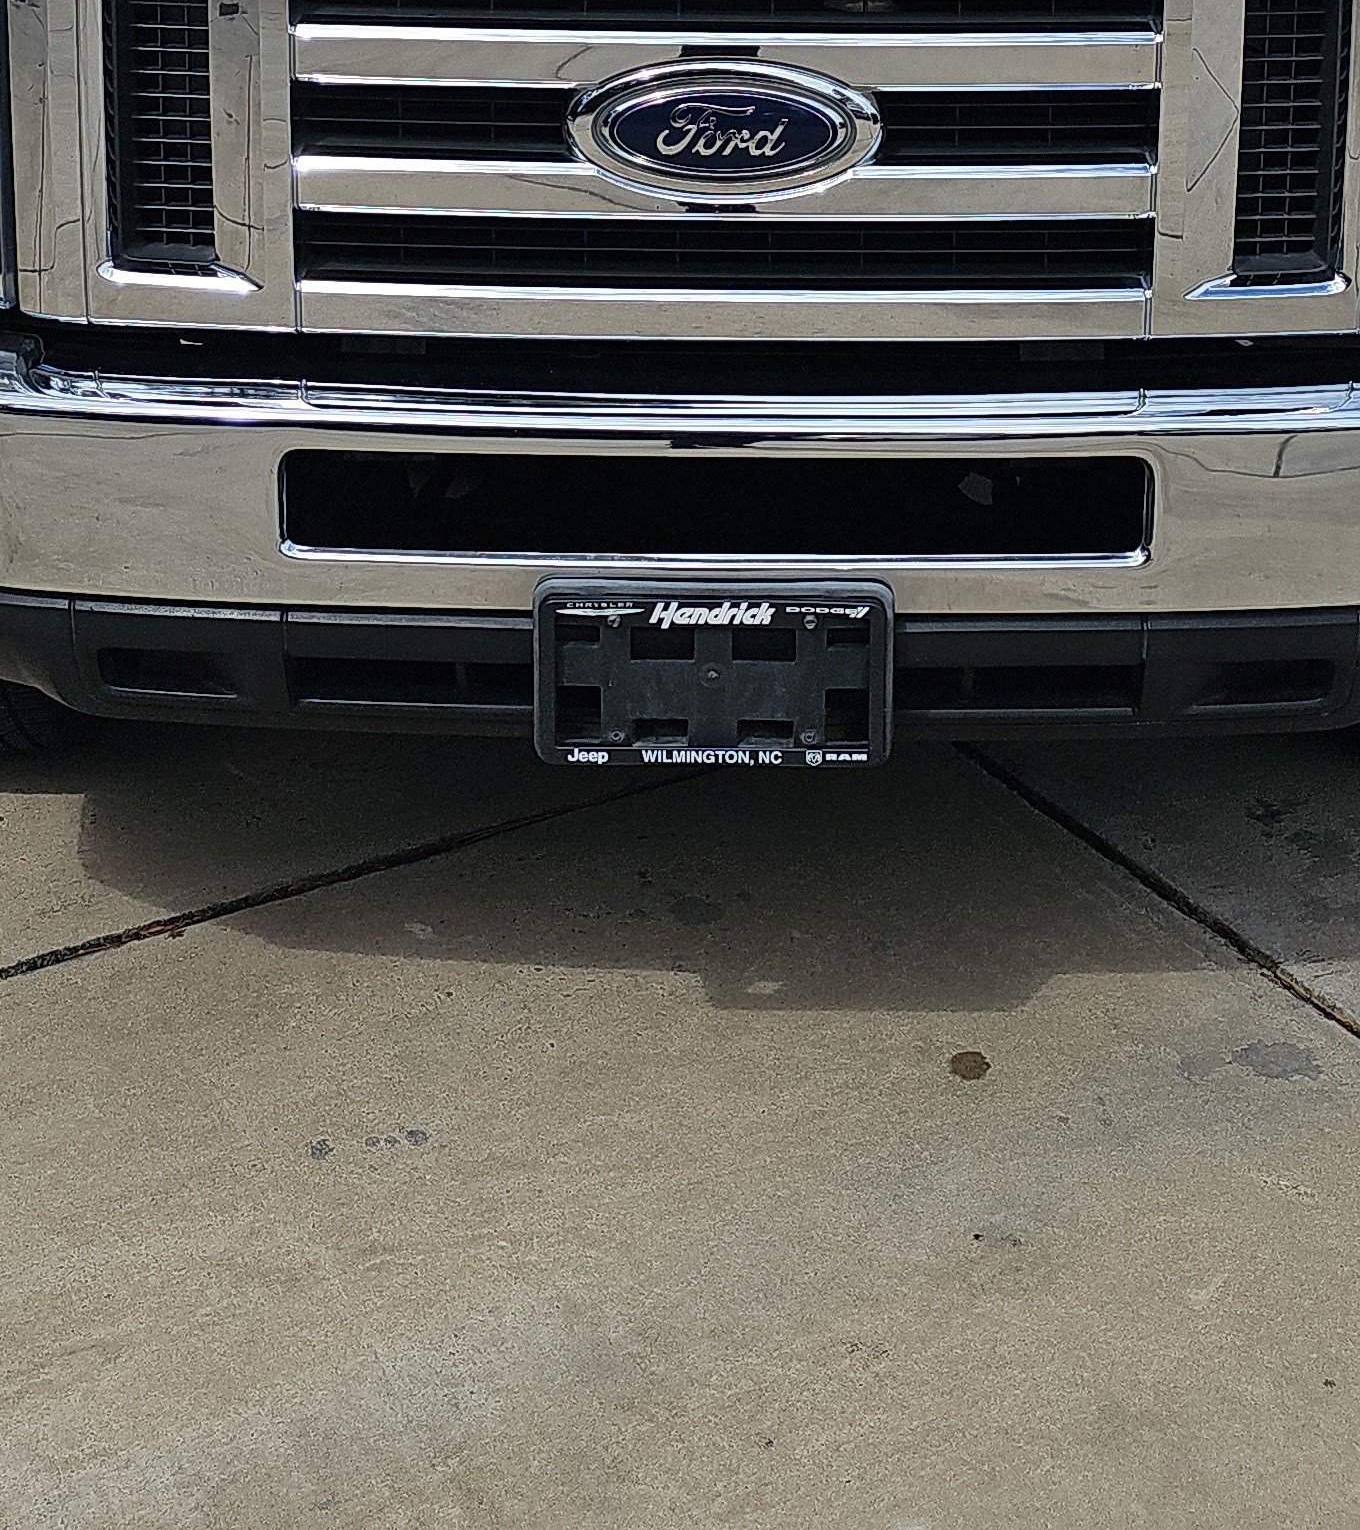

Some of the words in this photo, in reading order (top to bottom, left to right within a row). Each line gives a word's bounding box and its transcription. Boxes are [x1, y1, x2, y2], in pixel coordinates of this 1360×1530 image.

[656, 102, 789, 157] Ford
[648, 601, 777, 630] Hendrick
[567, 747, 610, 765] Jeep
[641, 749, 755, 767] WILMINGTON,
[758, 750, 784, 765] NC
[825, 753, 868, 761] RAM
